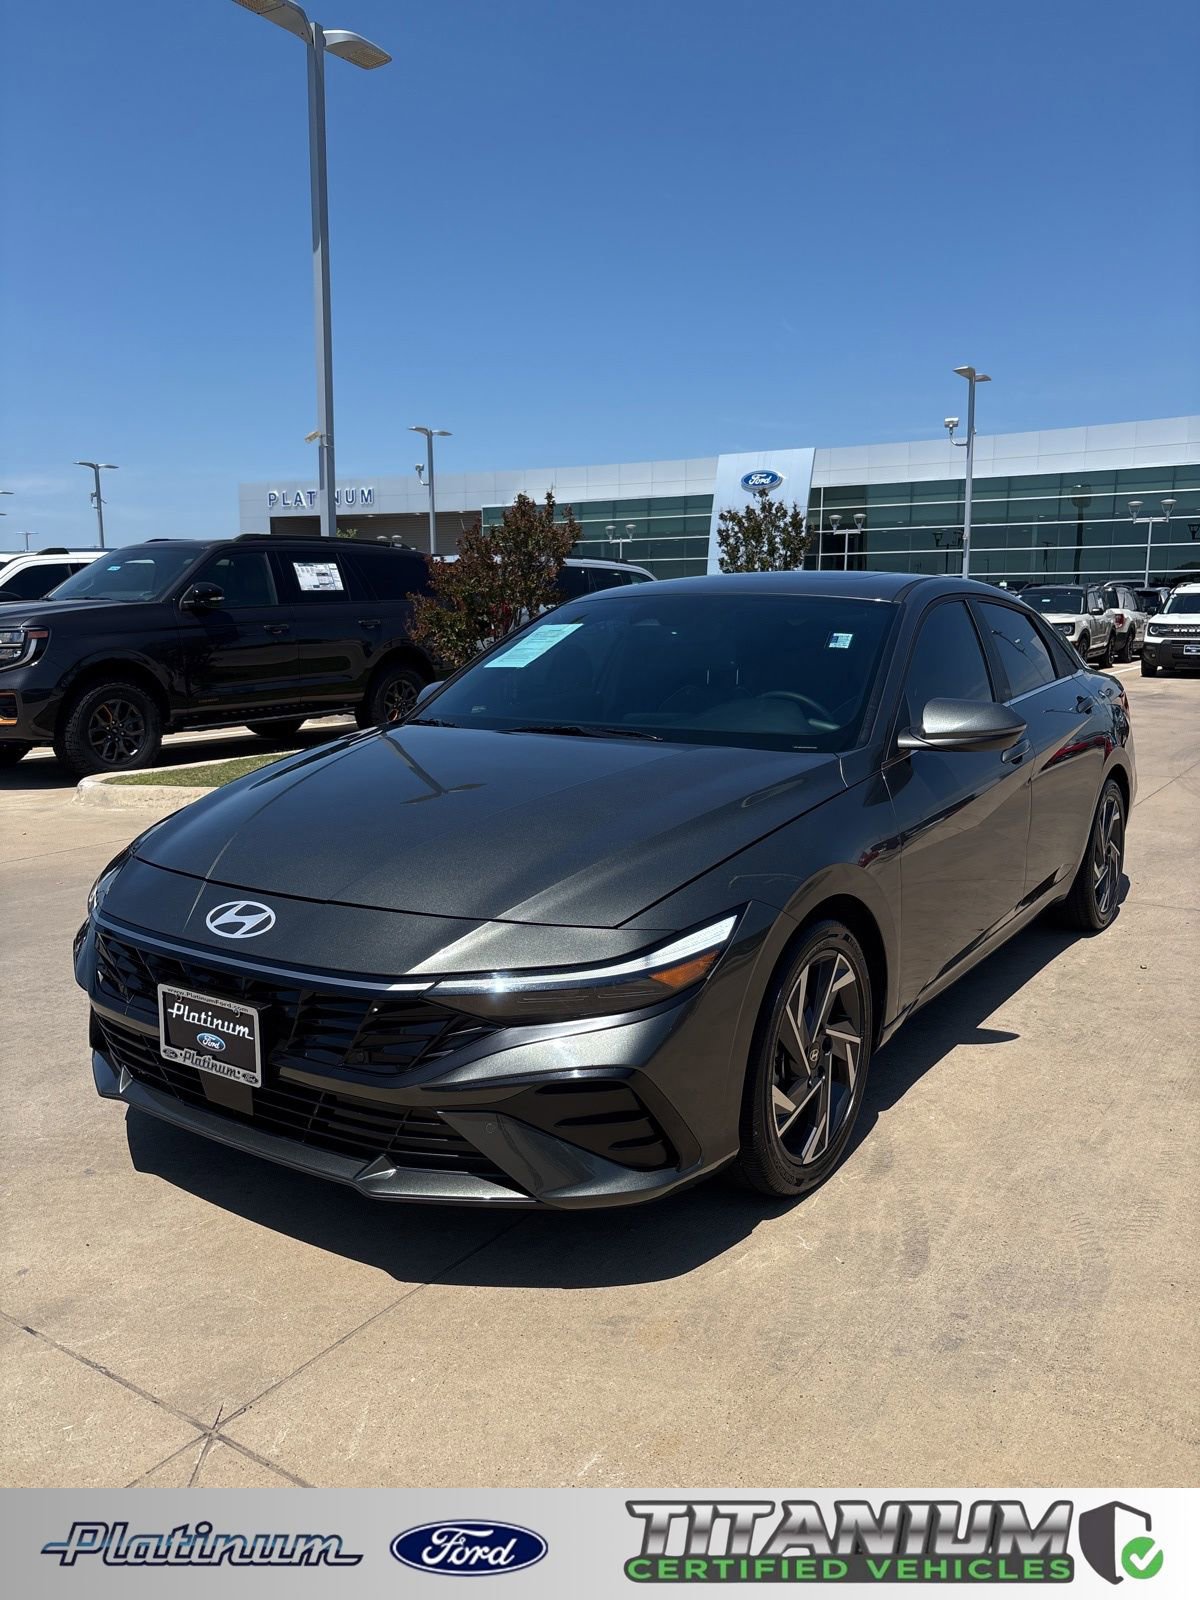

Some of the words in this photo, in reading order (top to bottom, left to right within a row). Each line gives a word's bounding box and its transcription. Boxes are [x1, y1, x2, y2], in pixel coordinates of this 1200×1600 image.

[749, 474, 772, 484] Ford
[167, 1002, 254, 1040] Platinum
[202, 1035, 220, 1049] Ford
[182, 1049, 241, 1080] Platinum
